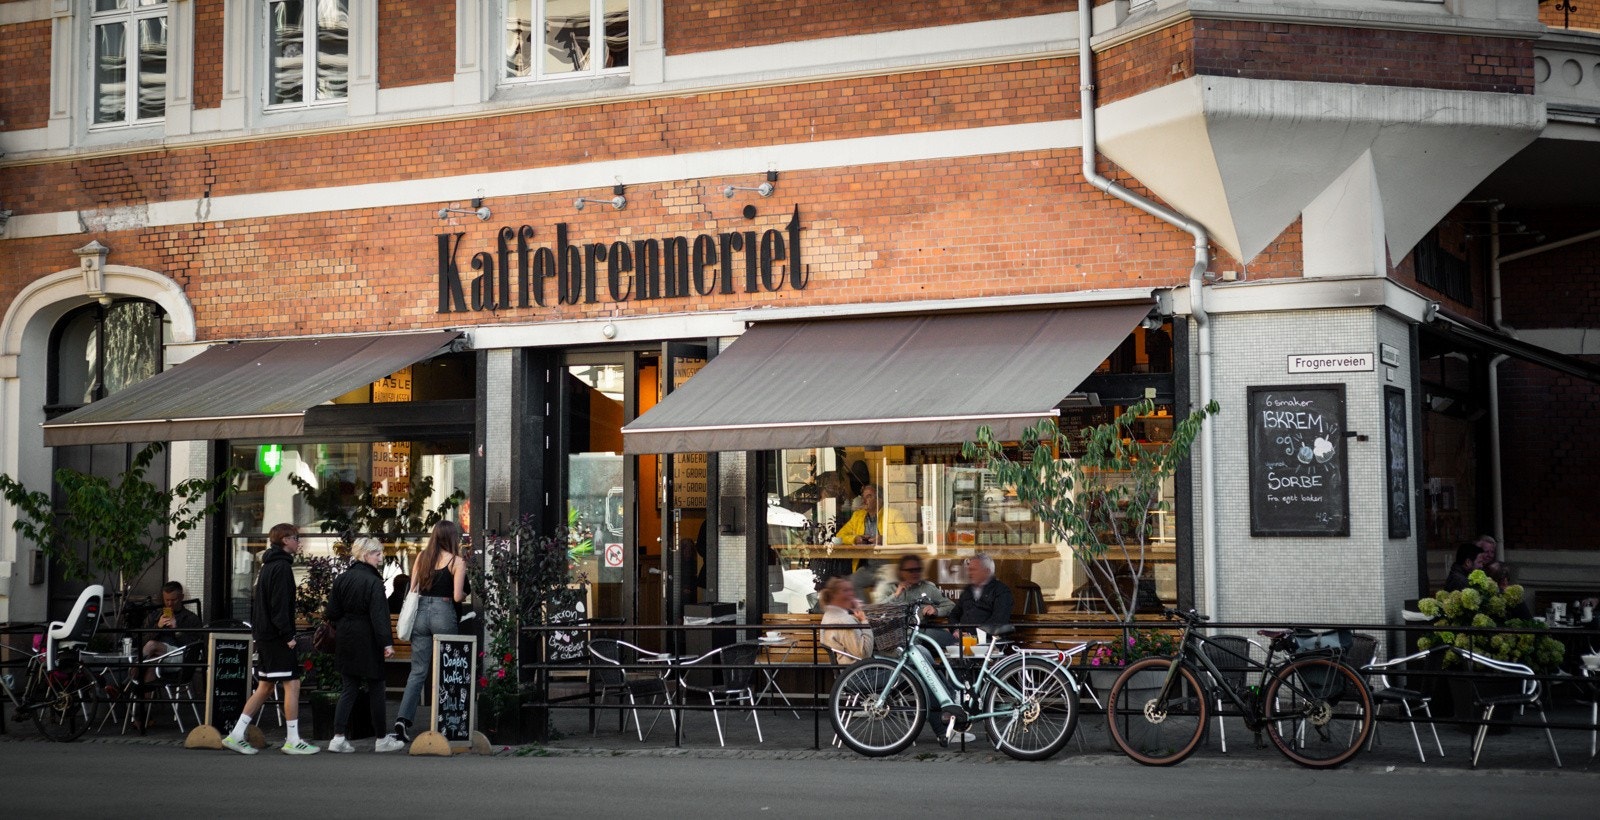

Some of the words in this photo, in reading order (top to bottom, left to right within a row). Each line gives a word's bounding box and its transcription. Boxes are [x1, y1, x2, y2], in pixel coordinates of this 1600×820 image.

[435, 203, 809, 314] Kaffebrenneriet
[1295, 357, 1366, 370] Frognerveien
[1265, 394, 1273, 407] 6
[1274, 396, 1314, 407] smaker
[1262, 410, 1324, 433] ISKREM
[1276, 436, 1295, 456] og
[677, 453, 707, 464] LANGERU
[1267, 471, 1323, 491] SORBE
[443, 653, 468, 670] Dagens
